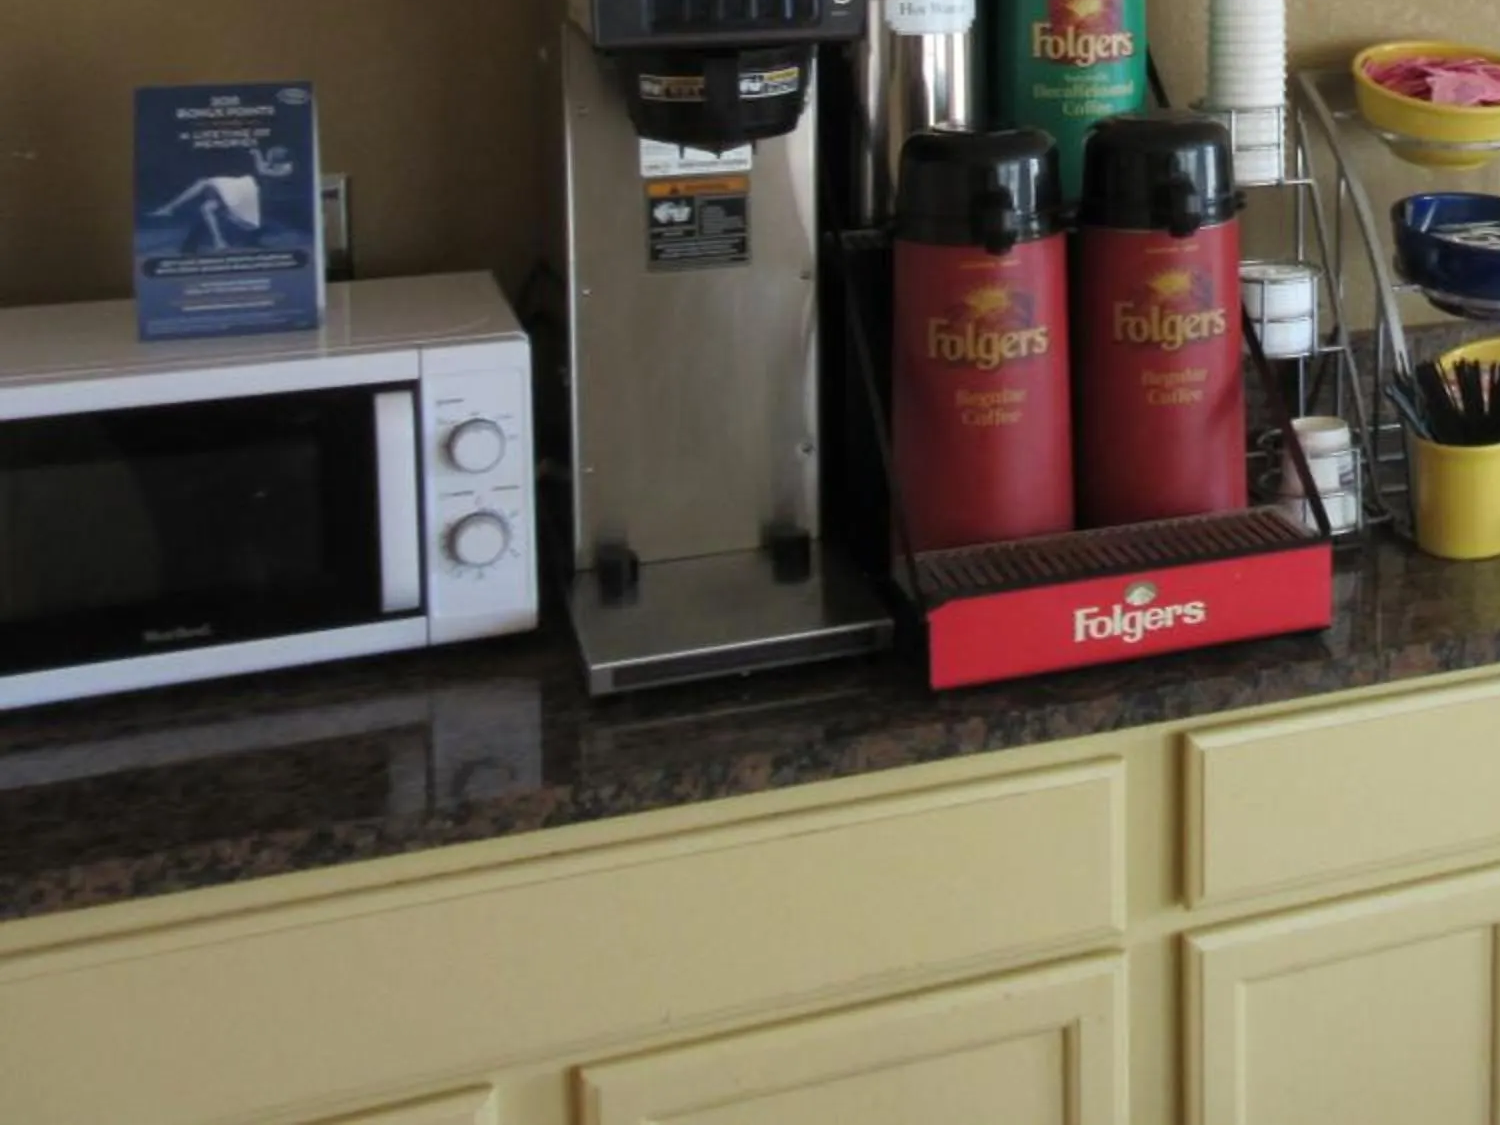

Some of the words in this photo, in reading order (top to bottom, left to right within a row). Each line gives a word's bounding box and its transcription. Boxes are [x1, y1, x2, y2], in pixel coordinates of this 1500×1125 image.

[1031, 22, 1134, 67] Folgers
[928, 318, 1049, 370] Folgers
[1113, 301, 1226, 351] Folgers
[1073, 600, 1206, 643] Folgers
